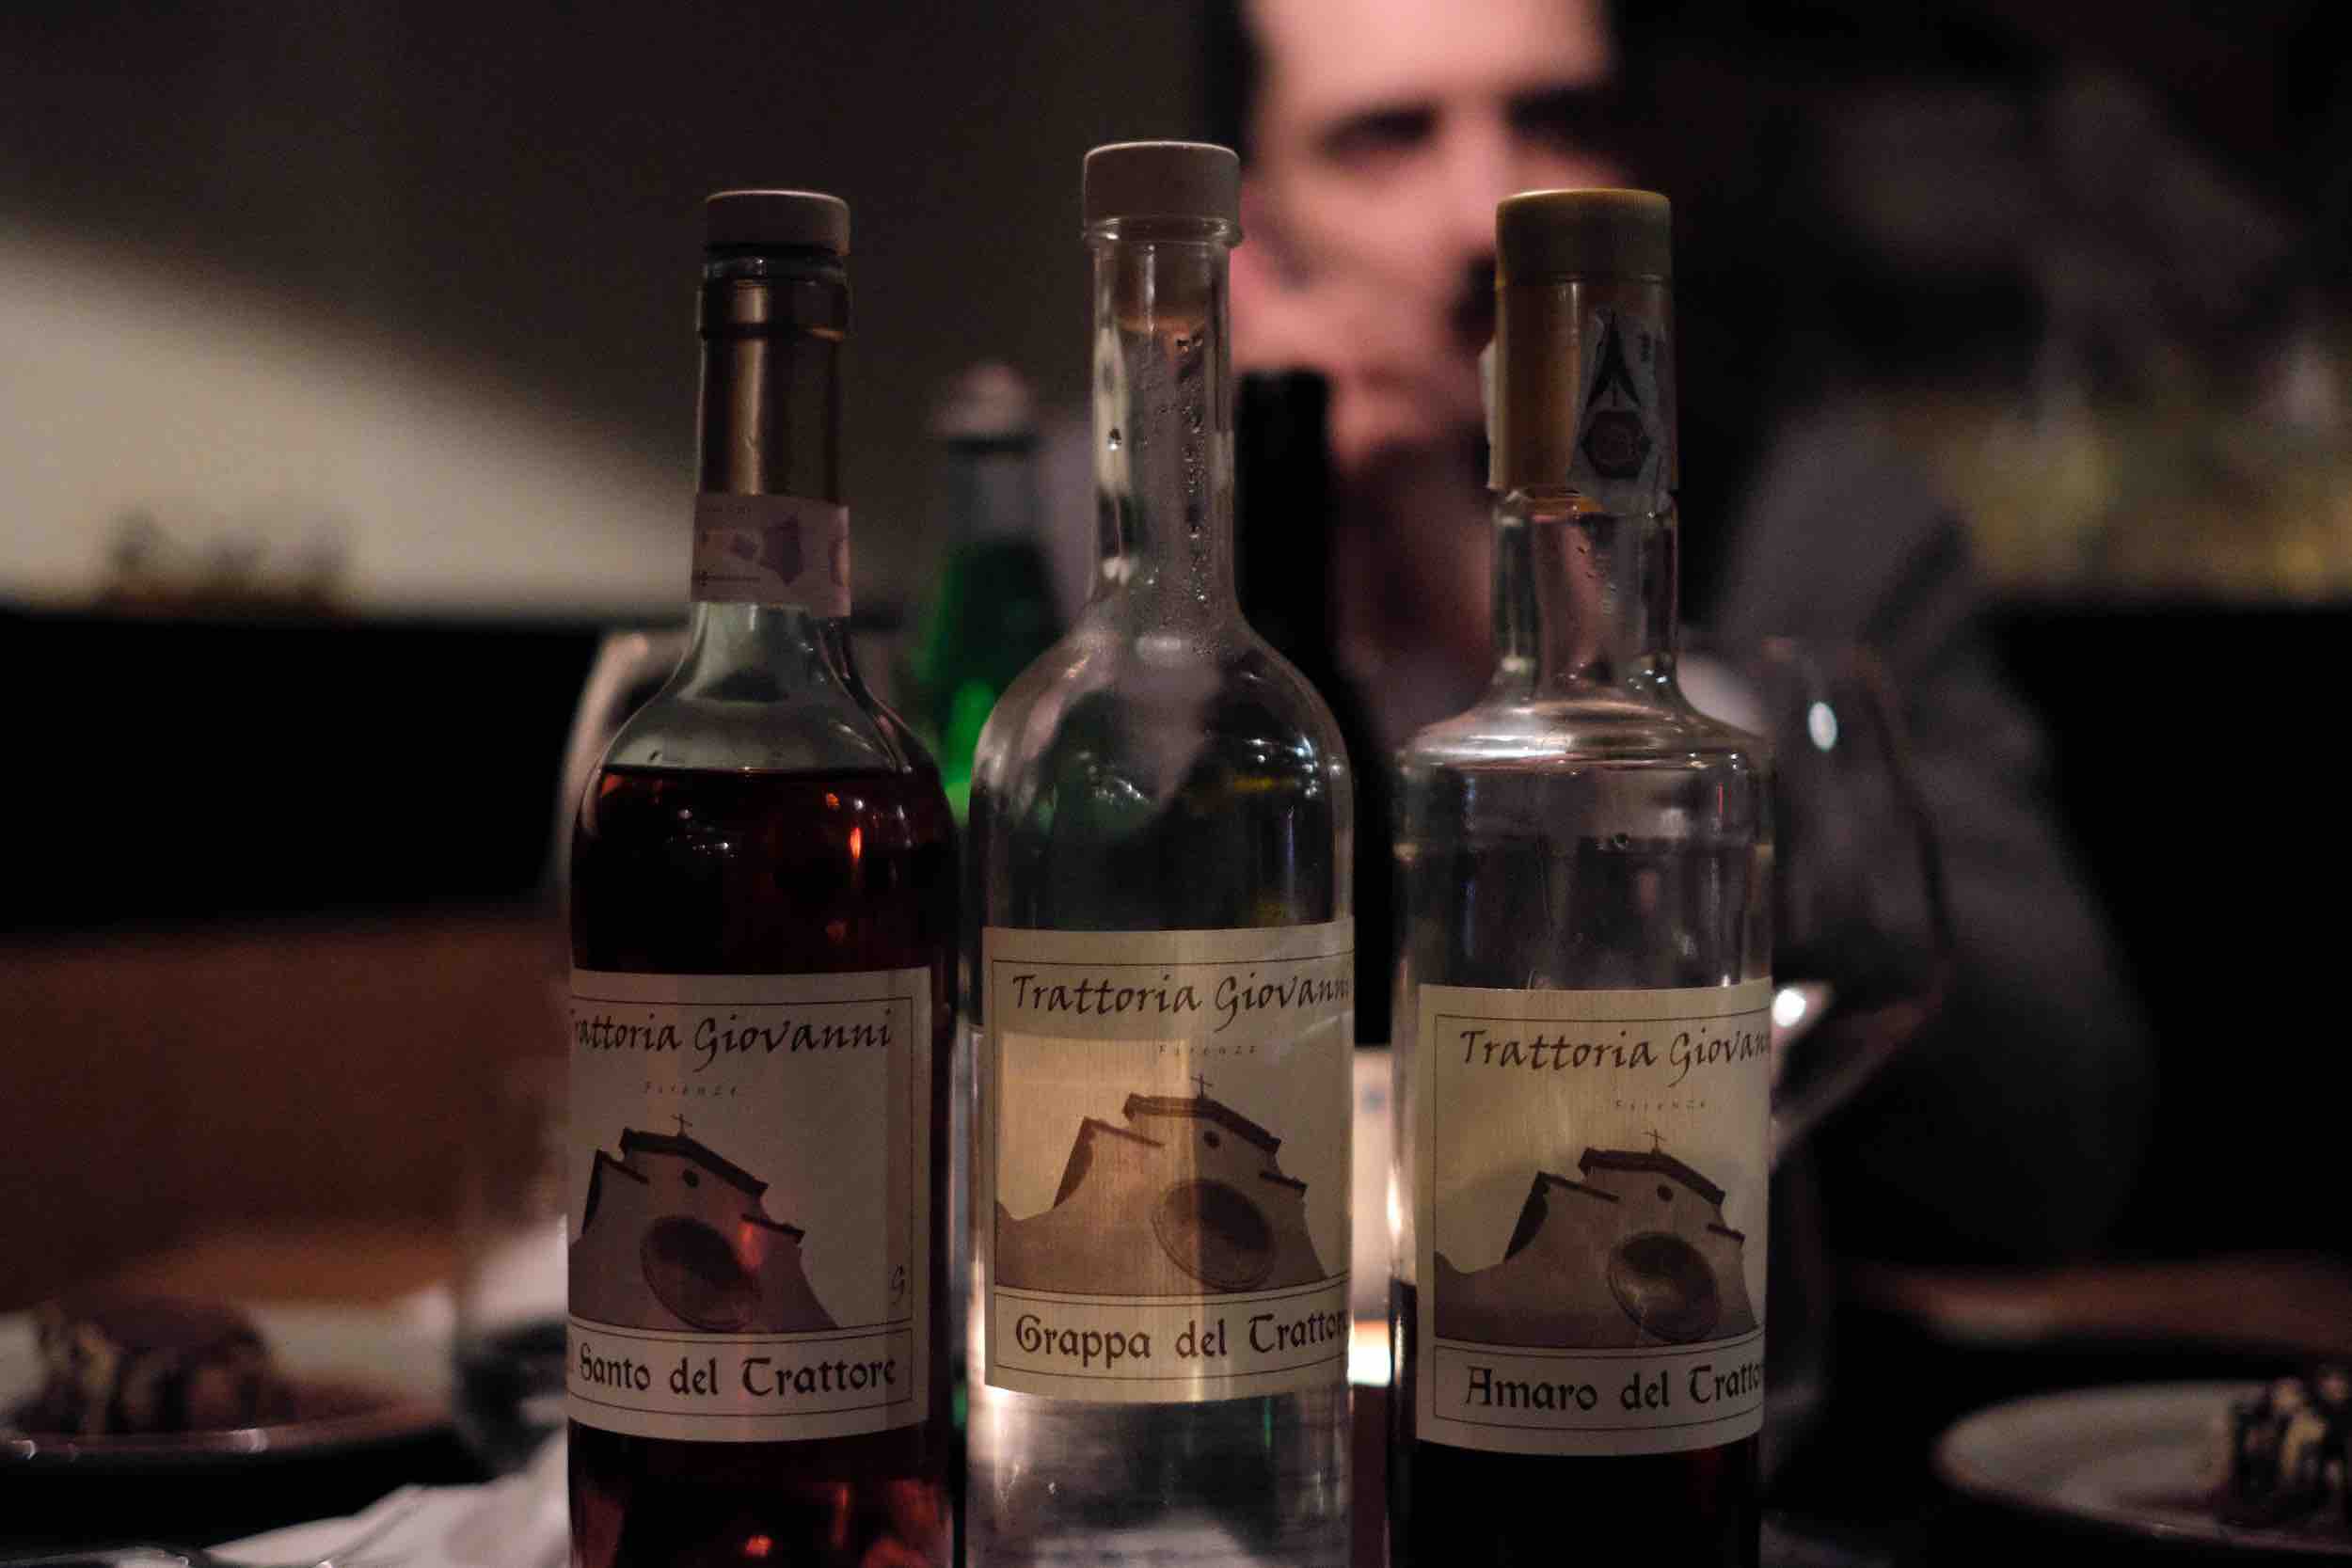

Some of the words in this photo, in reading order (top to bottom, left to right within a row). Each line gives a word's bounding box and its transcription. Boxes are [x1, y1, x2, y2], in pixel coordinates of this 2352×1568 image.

[1012, 974, 1203, 1016] Trattoria
[691, 1007, 893, 1073] Giovanni
[1460, 1030, 1659, 1071] Trattoria
[1668, 1027, 1771, 1088] Giovan
[1015, 1315, 1152, 1370] Grappa
[1175, 1320, 1228, 1359] del
[1248, 1308, 1349, 1354] Trattor
[580, 1341, 652, 1391] Santo
[669, 1357, 719, 1396] del
[741, 1356, 897, 1397] Trattore
[1465, 1366, 1597, 1411] Amaro
[1620, 1370, 1671, 1409] del
[1689, 1362, 1763, 1404] Tratto
